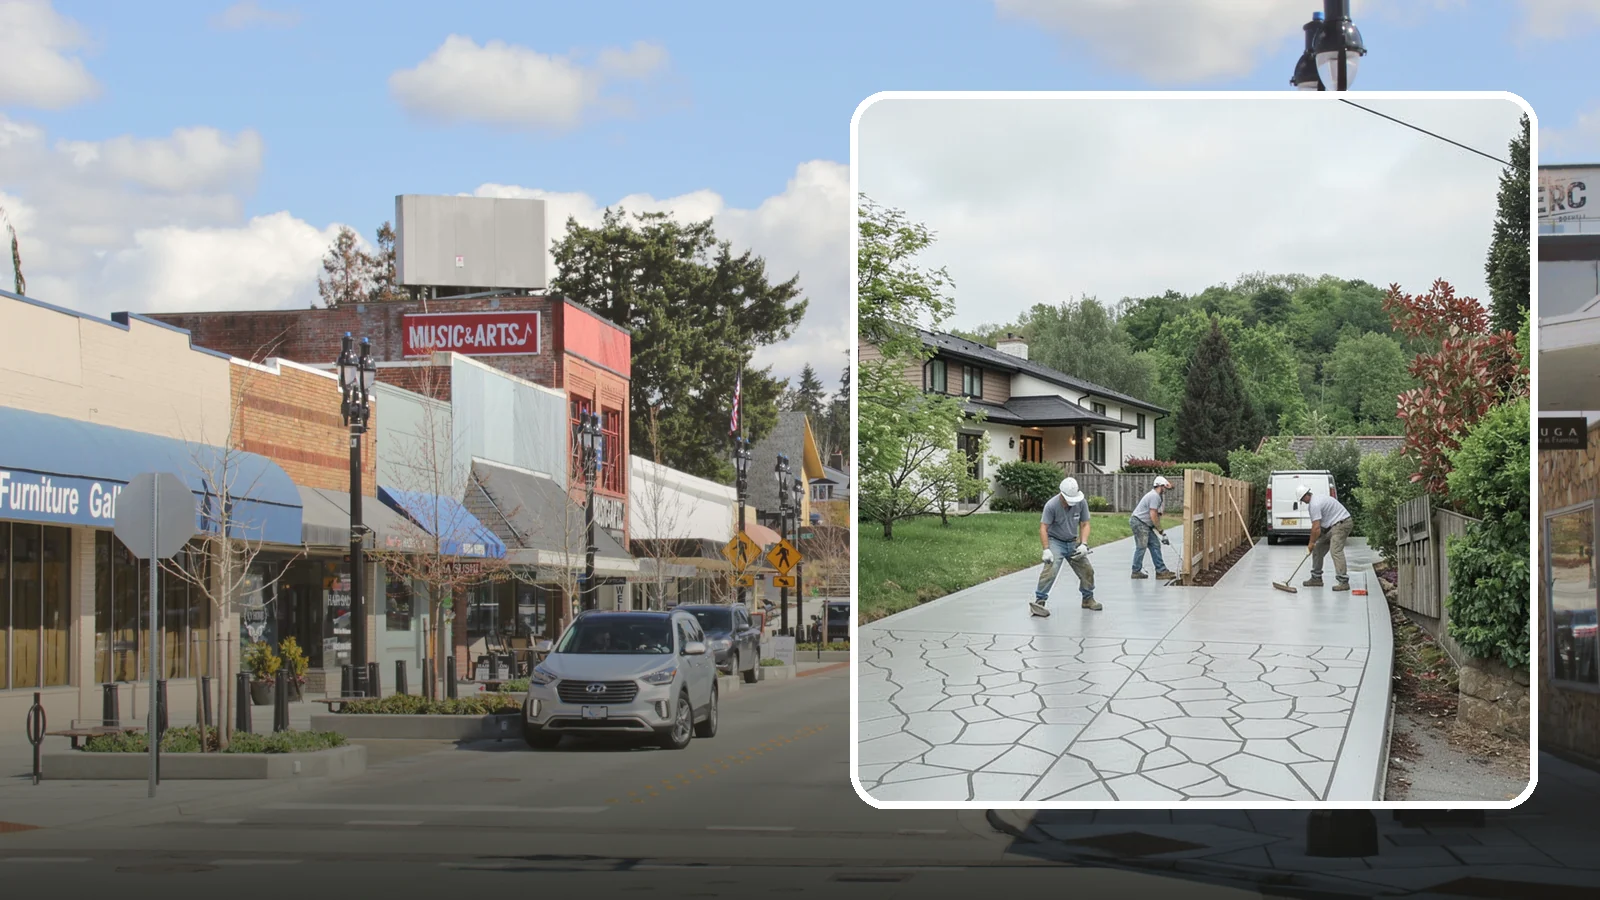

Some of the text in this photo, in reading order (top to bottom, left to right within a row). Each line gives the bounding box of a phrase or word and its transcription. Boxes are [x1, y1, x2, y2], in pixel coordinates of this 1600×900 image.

[409, 323, 519, 348] MUSIC&ARTS
[1540, 427, 1578, 436] UGA
[0, 472, 121, 519] Furniture Gal
[453, 563, 479, 574] SUSHI
